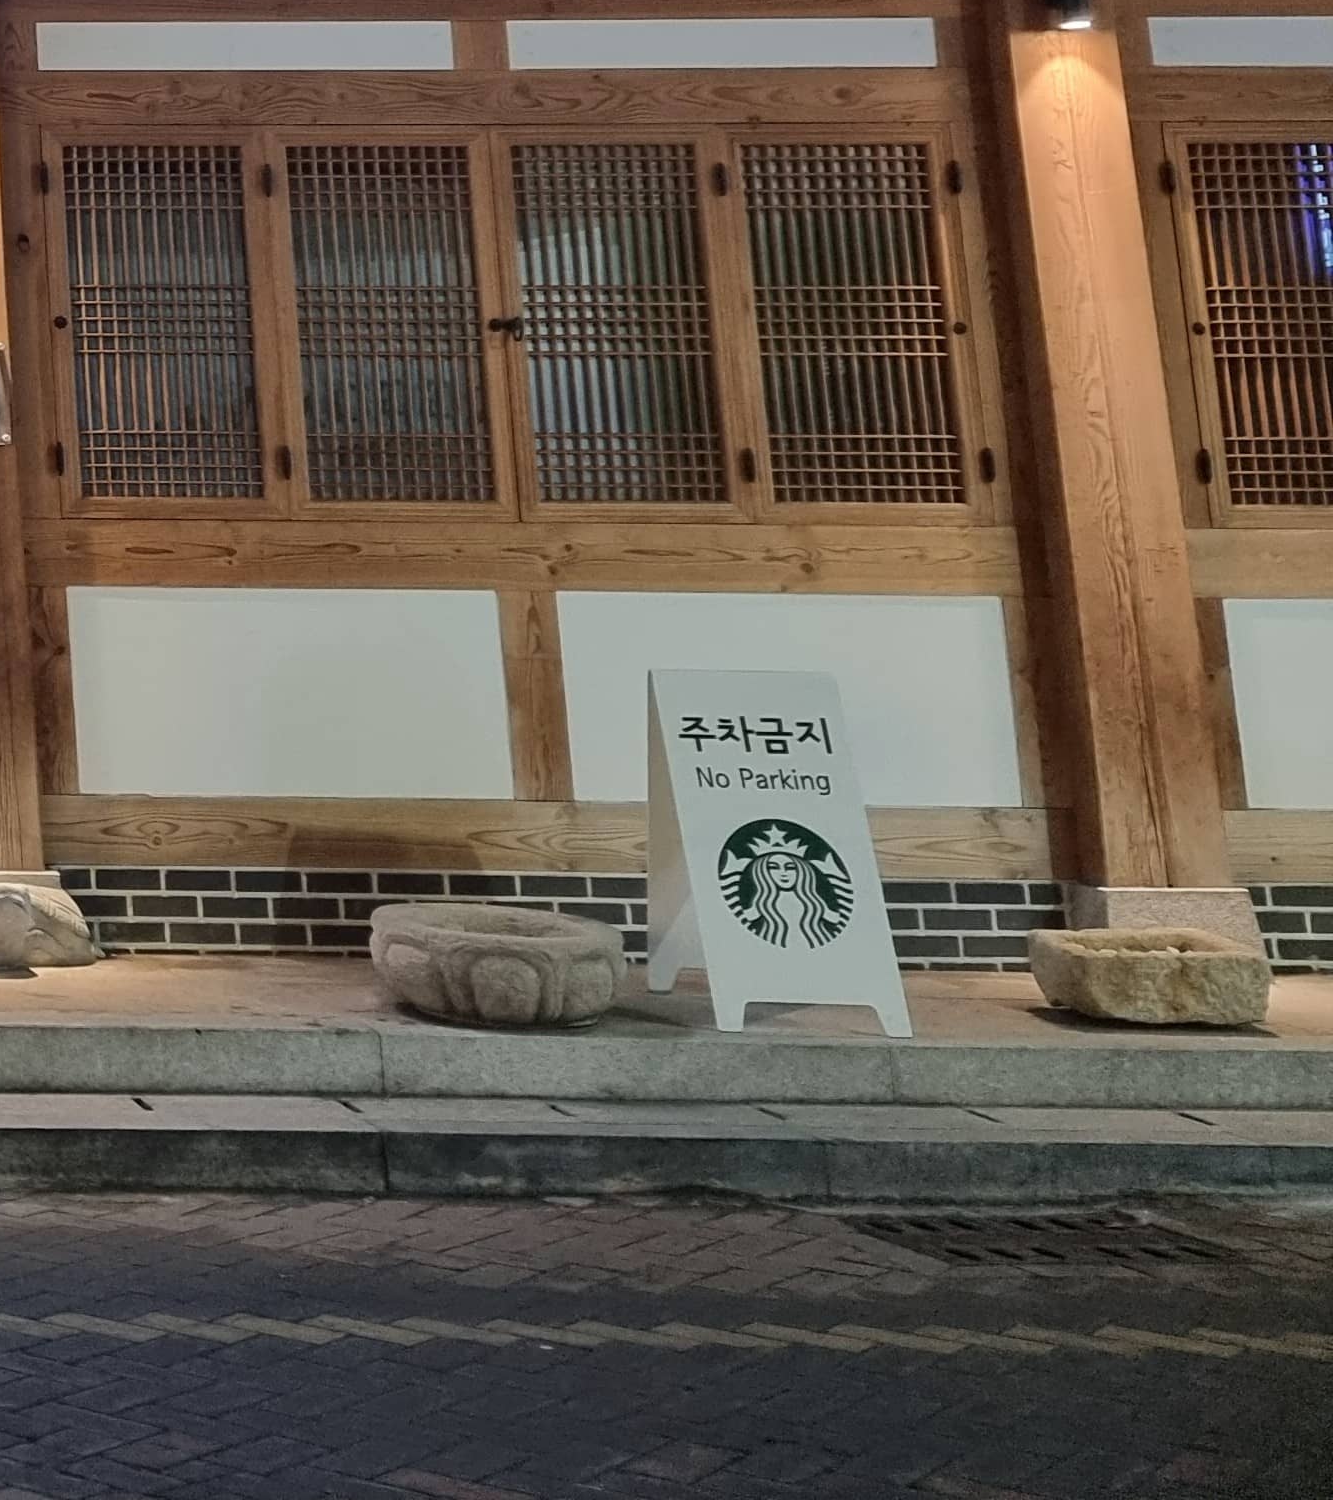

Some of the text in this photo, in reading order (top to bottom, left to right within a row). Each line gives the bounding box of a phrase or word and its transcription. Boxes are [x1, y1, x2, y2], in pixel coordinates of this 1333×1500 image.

[678, 715, 833, 754] 주차금지
[695, 766, 832, 796] No Parking
